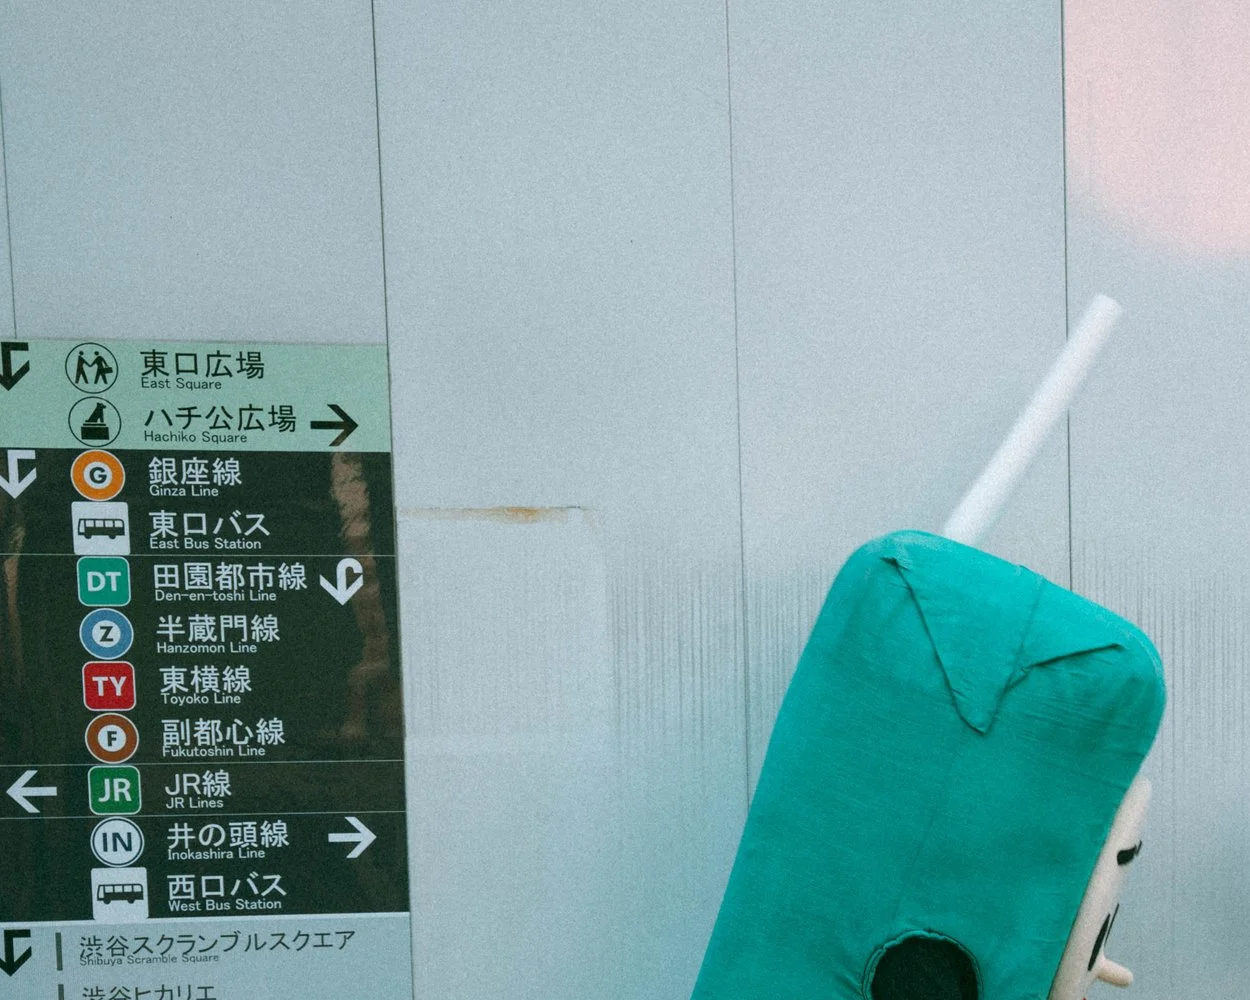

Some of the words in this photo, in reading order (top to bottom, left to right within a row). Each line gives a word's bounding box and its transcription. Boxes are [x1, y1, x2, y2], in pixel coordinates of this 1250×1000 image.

[140, 349, 265, 378] 東口広場
[141, 377, 172, 390] East
[176, 378, 222, 390] Square
[144, 403, 297, 432] ハチ公広場
[144, 432, 196, 443] Hachiko
[202, 432, 247, 444] Square
[90, 467, 107, 484] G
[148, 456, 243, 486] 銀座線
[149, 485, 186, 496] Ginza
[191, 485, 219, 496] Line
[149, 510, 270, 538] 東口バス
[150, 538, 180, 549] East
[184, 538, 209, 549] Bus
[214, 538, 261, 549] Station
[87, 573, 121, 591] DT
[153, 562, 307, 590] 田園都市線
[155, 590, 245, 601] Den-en-toshi
[250, 590, 276, 601] Line
[100, 626, 114, 641] Z
[157, 615, 279, 642] 半蔵門線
[157, 642, 227, 653] Hanzomon
[231, 641, 257, 653] Line
[93, 676, 126, 696] TY
[159, 666, 252, 694] 東横線
[161, 693, 210, 704] Toyoko
[214, 693, 241, 704] Line
[107, 731, 117, 746] F
[161, 718, 286, 747] 副都心線
[163, 746, 234, 757] Fukutoshin
[238, 746, 265, 756] Line
[99, 779, 130, 802] JR
[165, 770, 232, 798] JR線
[166, 797, 185, 809] JR
[189, 797, 223, 809] Lines
[102, 832, 132, 852] IN
[167, 820, 290, 849] 井の頭線
[168, 849, 233, 860] Inokashira
[238, 849, 265, 859] Line
[167, 872, 287, 900] 西口バス
[168, 900, 202, 911] West
[206, 899, 232, 911] Bus
[236, 898, 281, 910] Station
[80, 930, 355, 958] 渋谷スクランブルスクエア
[80, 954, 122, 966] Shibuya
[127, 954, 178, 964] Scramble
[182, 953, 219, 963] Square
